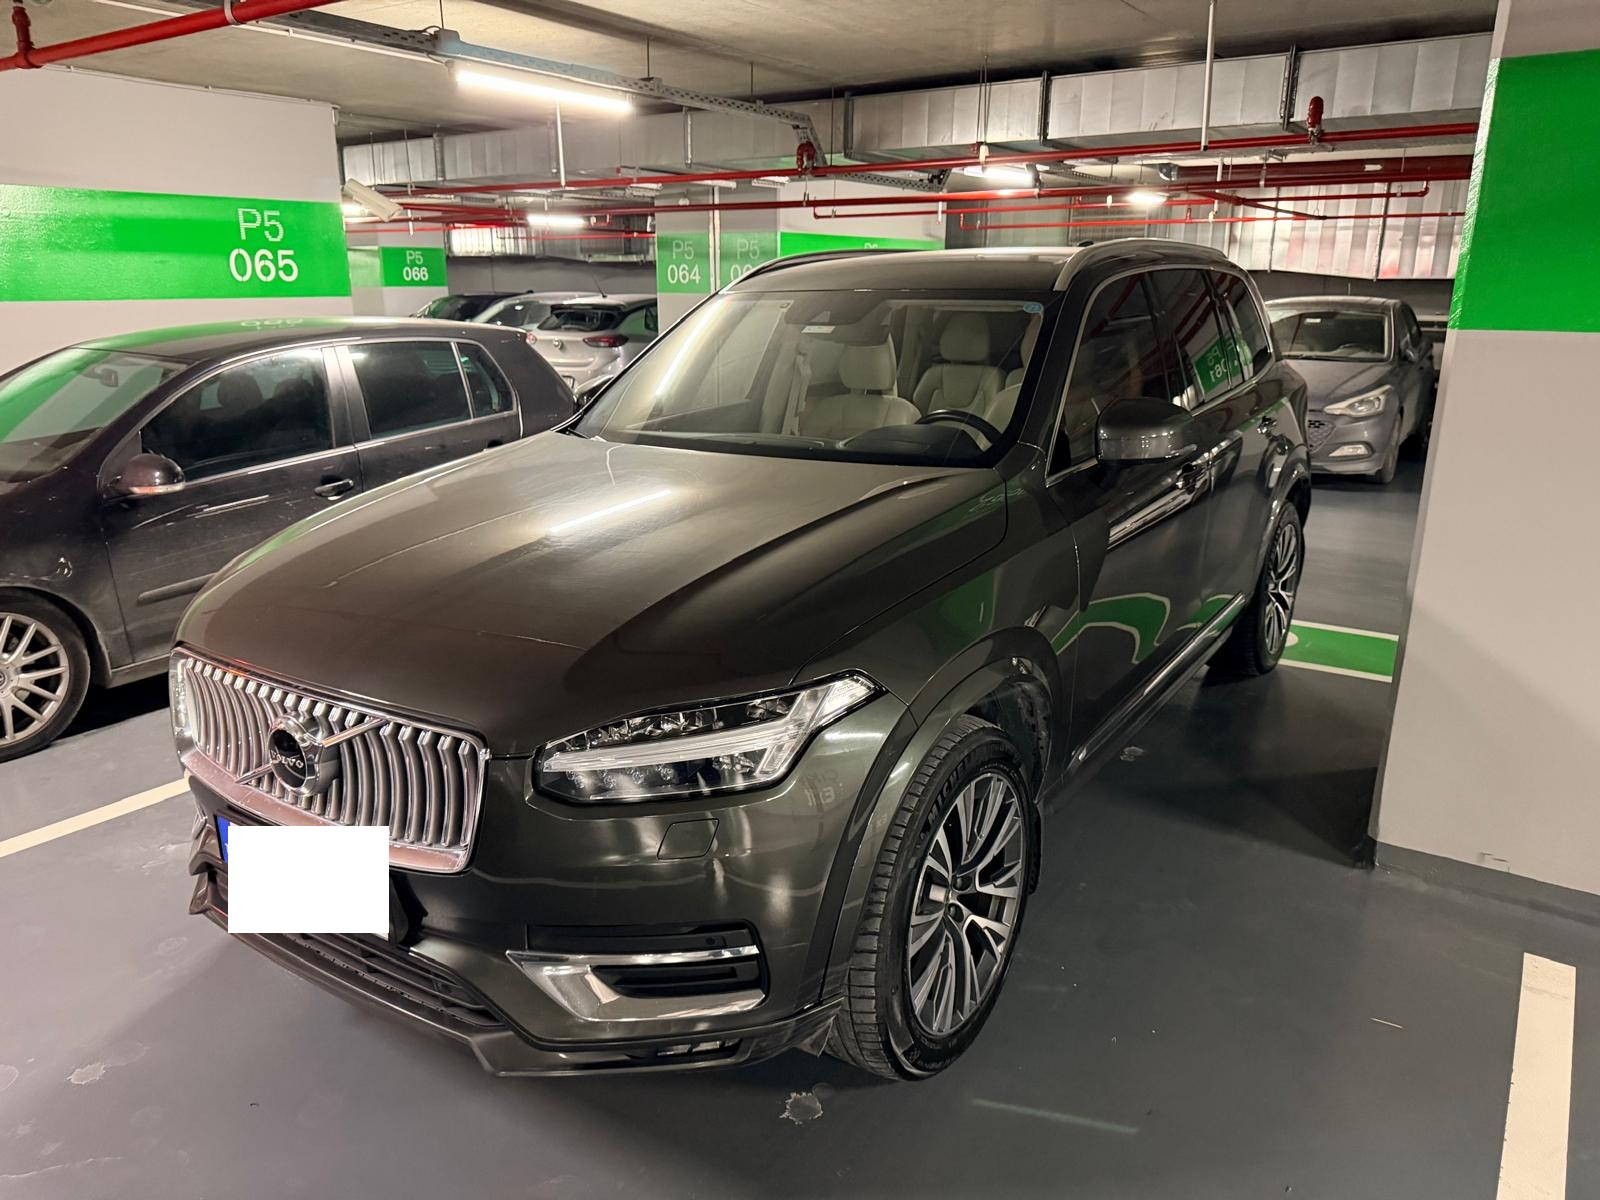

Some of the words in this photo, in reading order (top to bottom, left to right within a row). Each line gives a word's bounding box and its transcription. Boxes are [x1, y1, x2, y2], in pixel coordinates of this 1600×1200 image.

[237, 207, 285, 243] P5
[405, 250, 424, 265] P5
[671, 239, 695, 260] P5
[736, 238, 760, 260] P5
[228, 248, 299, 283] 065
[402, 266, 429, 281] 066
[667, 264, 702, 285] 064
[269, 749, 305, 769] VOLVO
